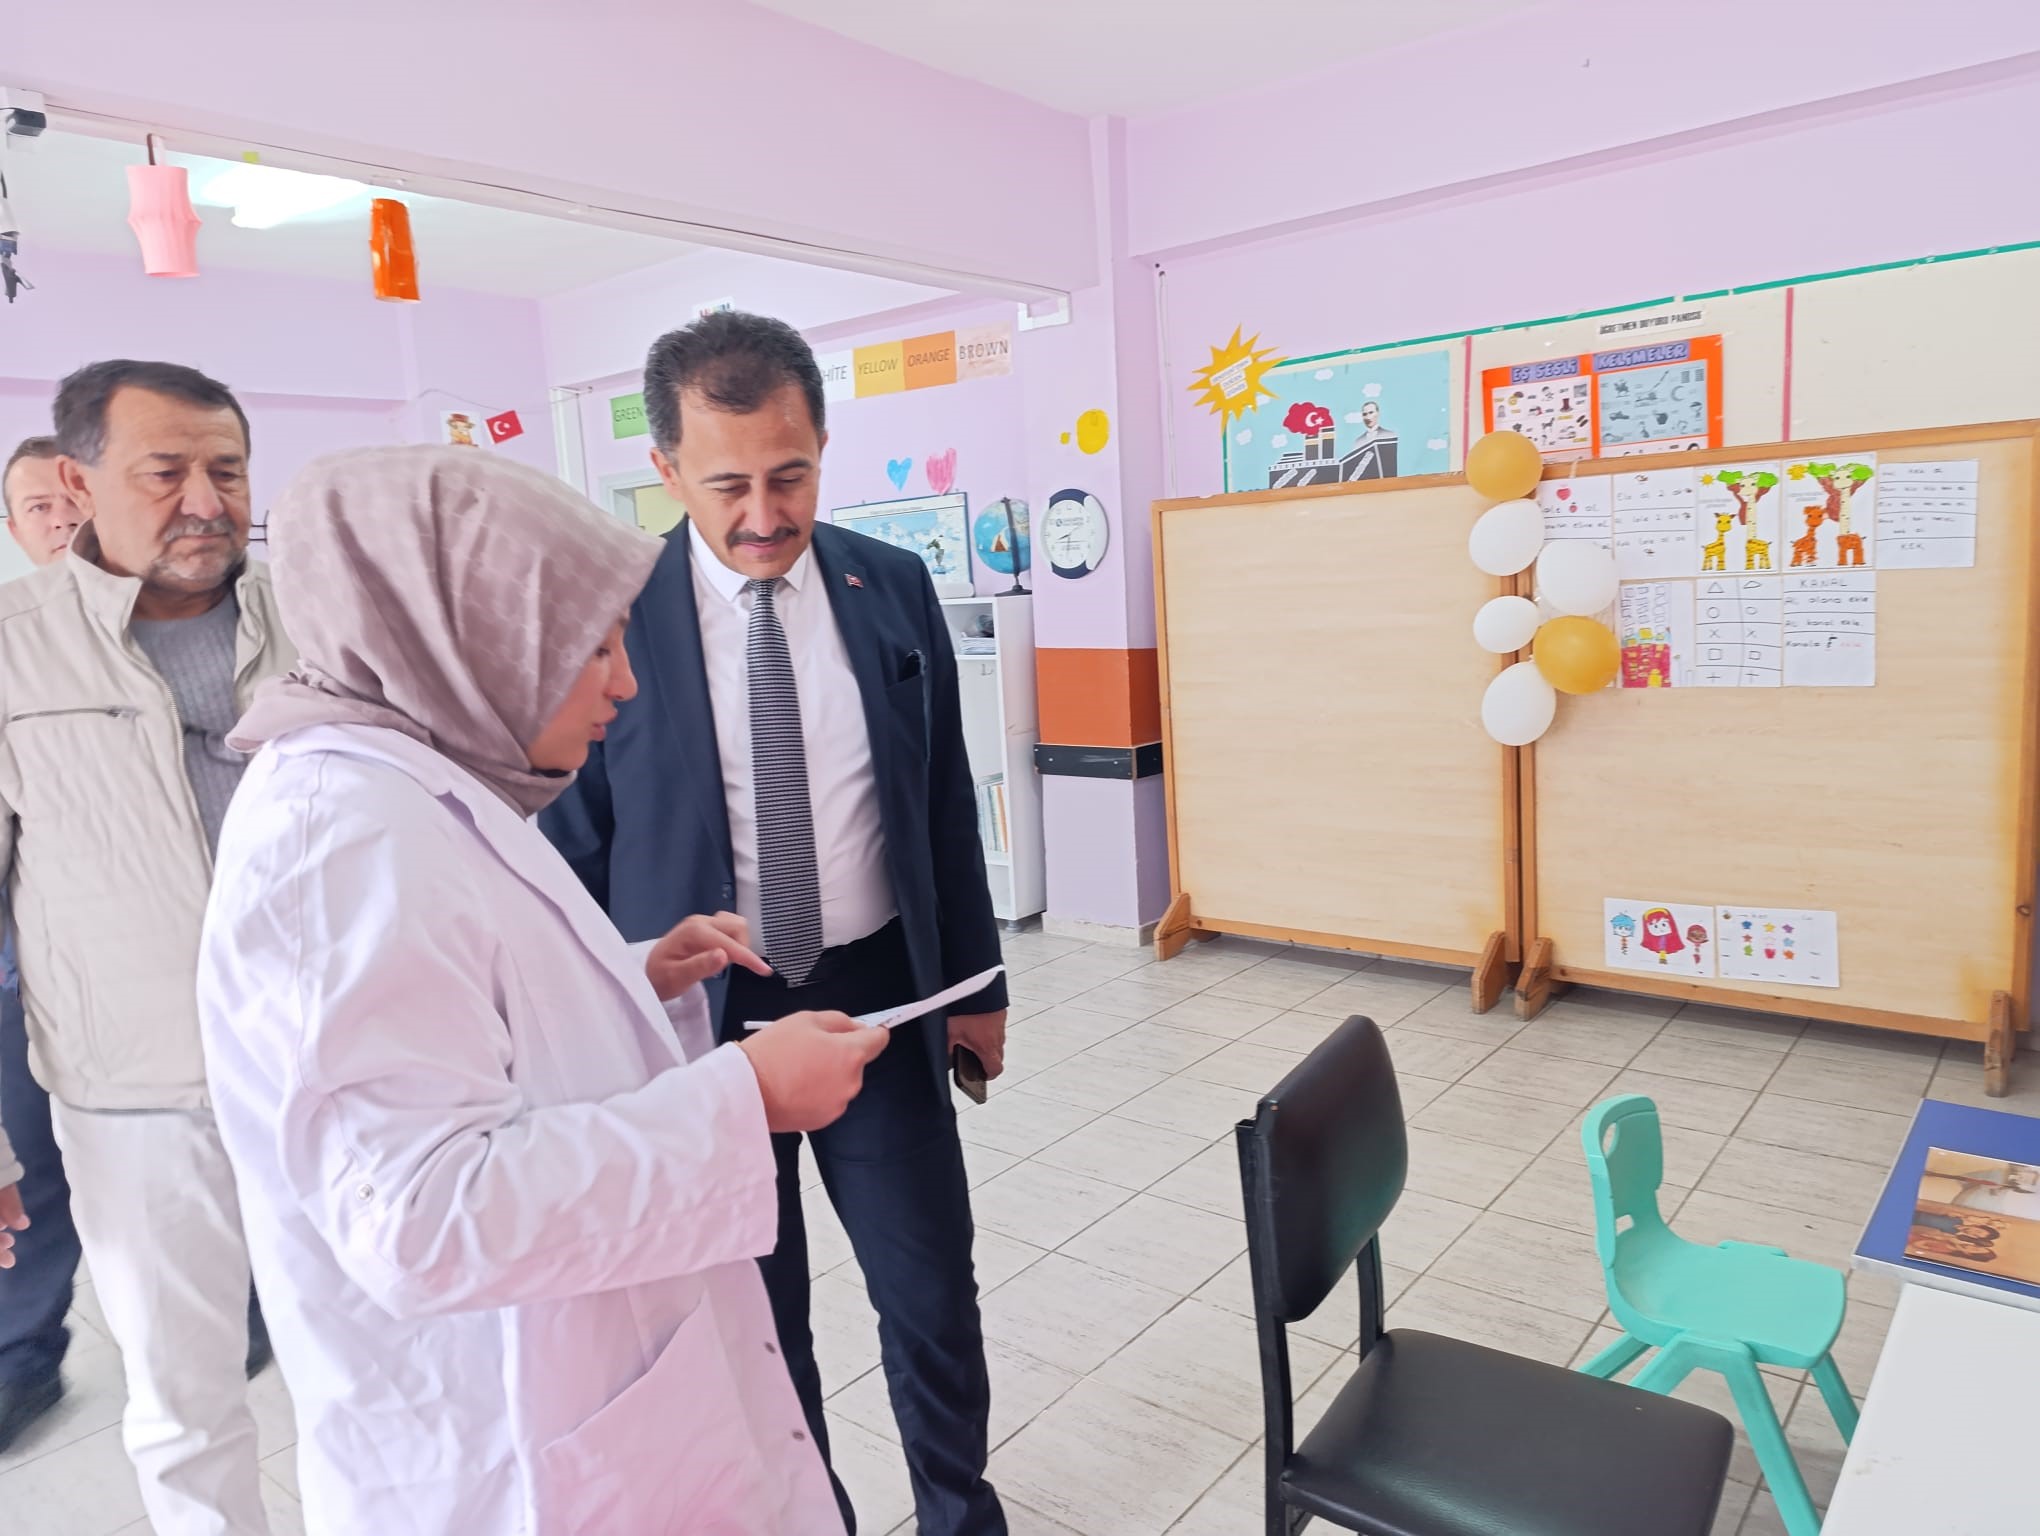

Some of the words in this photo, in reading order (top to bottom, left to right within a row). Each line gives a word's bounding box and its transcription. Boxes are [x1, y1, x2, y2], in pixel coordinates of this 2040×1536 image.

[907, 348, 950, 368] ORANGE
[959, 339, 1009, 361] BROWN
[857, 358, 899, 376] YELLOW
[1512, 366, 1531, 383] EŞ
[1535, 359, 1578, 379] SESLİ
[1597, 343, 1687, 370] KELİMELER
[822, 364, 848, 384] HİTE
[615, 406, 645, 423] GREEN
